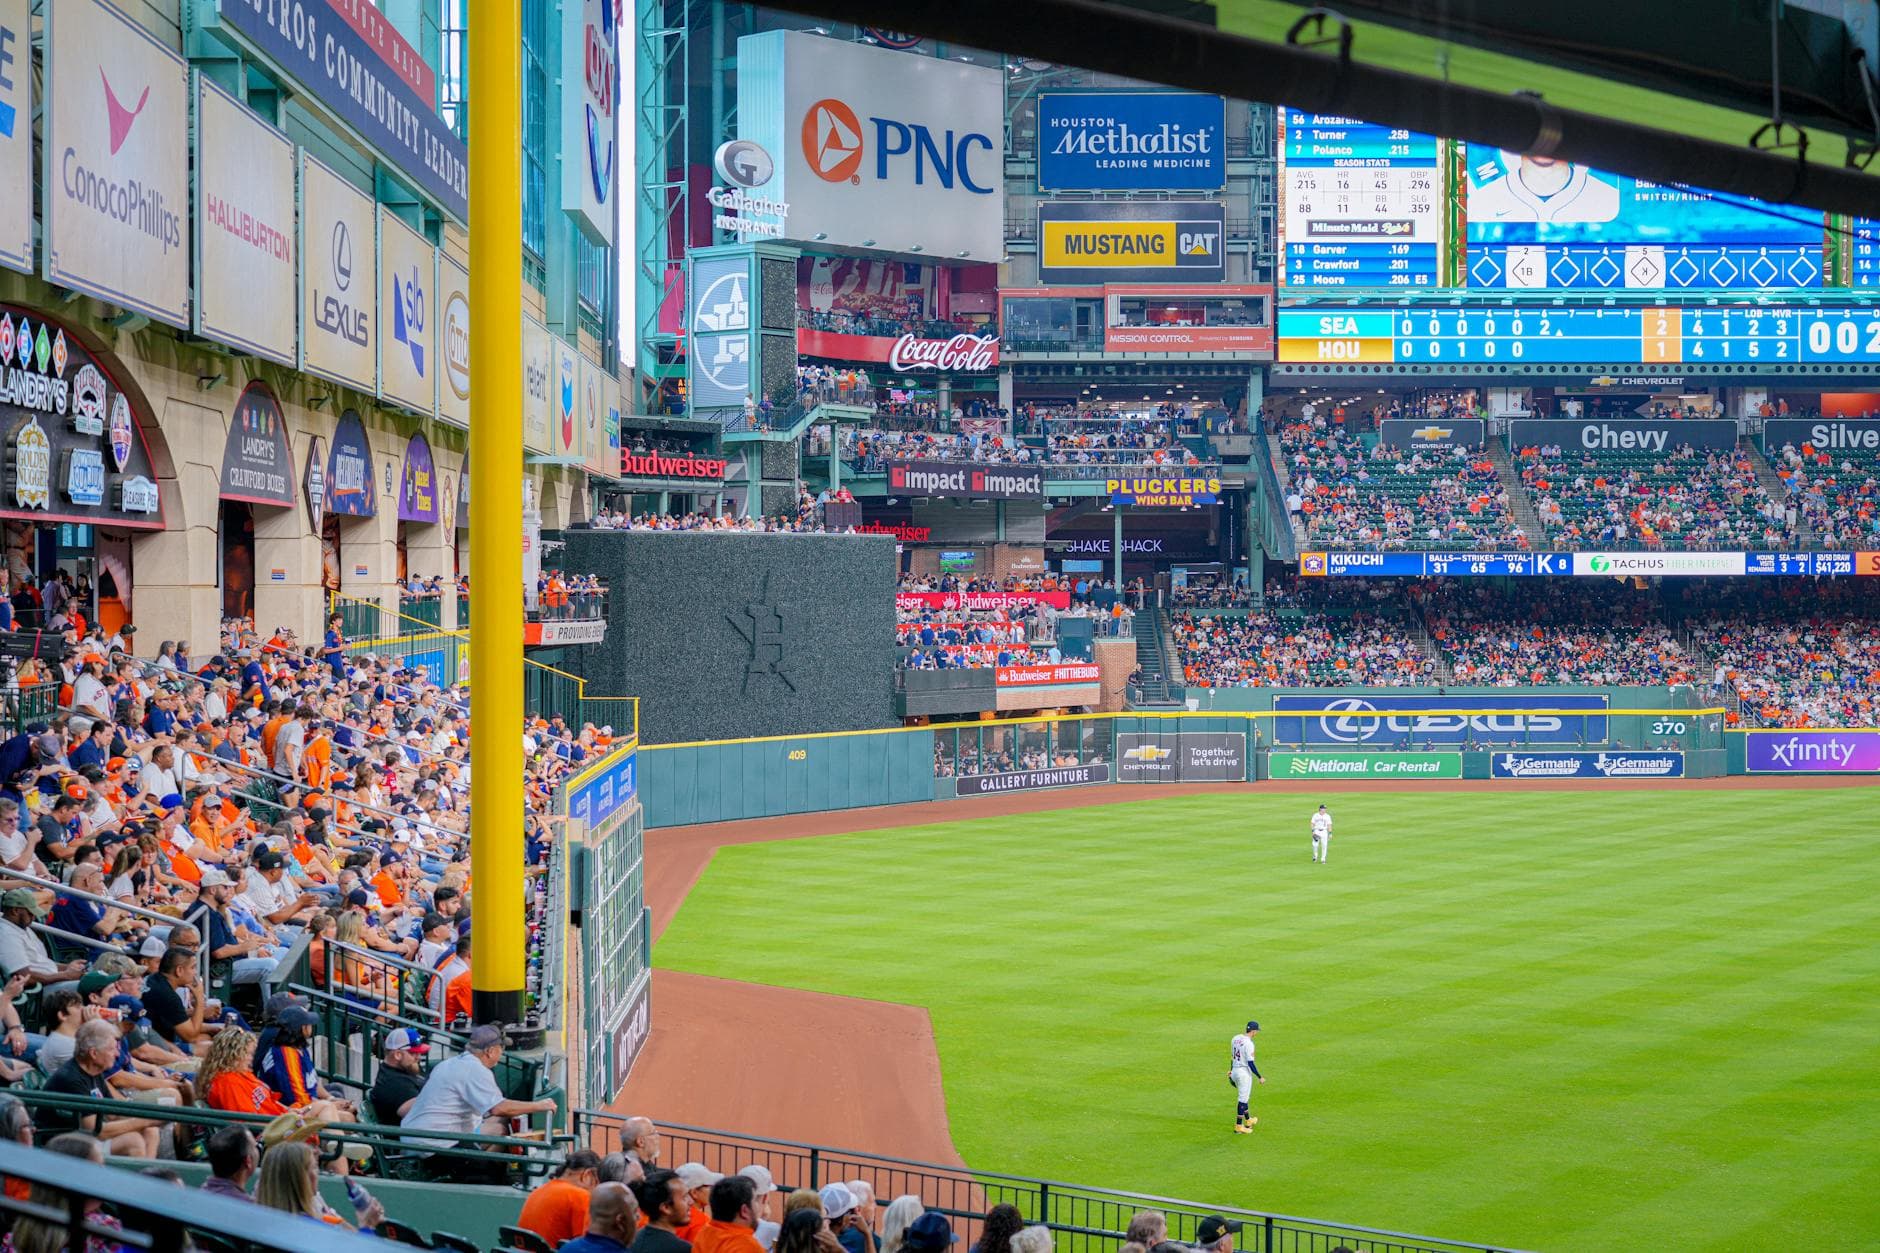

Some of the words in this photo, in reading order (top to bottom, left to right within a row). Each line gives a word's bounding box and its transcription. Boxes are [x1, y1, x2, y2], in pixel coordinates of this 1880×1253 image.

[393, 40, 420, 86] MAID
[325, 33, 419, 154] COMMUNITY
[1051, 118, 1115, 127] HOUSTON
[1292, 115, 1305, 125] 56
[1051, 123, 1211, 154] Methodist
[1295, 130, 1302, 140] 2
[1312, 130, 1347, 140] Turner
[868, 117, 994, 194] PNC
[1295, 145, 1302, 155] 7
[1312, 145, 1353, 155] Polanco
[1388, 145, 1410, 155] .215
[1096, 159, 1148, 168] LEADING
[1153, 159, 1211, 168] MEDICINE
[1334, 159, 1365, 167] SEASON
[1366, 159, 1390, 167] STATS
[1296, 171, 1314, 179] AVG
[1337, 171, 1349, 179] HR
[1374, 171, 1388, 179] RBI
[1294, 180, 1316, 189] .215
[1337, 180, 1350, 189] 16
[1375, 180, 1387, 189] 45
[1408, 180, 1430, 189] .296
[62, 147, 180, 254] ConocoPhillips
[706, 187, 790, 217] Gallagher
[1411, 194, 1427, 202] SLG
[1299, 204, 1311, 213] 88
[1337, 204, 1348, 213] 11
[1375, 204, 1387, 213] 44
[1408, 204, 1430, 213] .359
[208, 193, 290, 264] HALLIBURTON
[716, 215, 782, 237] INSURANCE
[1312, 221, 1350, 232] Minute
[1351, 221, 1379, 233] Maid
[1065, 234, 1165, 255] MUSTANG
[1179, 232, 1216, 255] CAT
[1293, 245, 1305, 254] 18
[1313, 245, 1347, 254] Garver
[1388, 245, 1410, 254] .169
[1562, 247, 1569, 256] 3
[1760, 247, 1767, 256] 8
[1800, 247, 1806, 256] 9
[1858, 245, 1871, 255] 10
[1295, 260, 1302, 269] 3
[1313, 260, 1359, 269] Crawford
[1388, 260, 1409, 269] .201
[1858, 260, 1871, 269] 14
[1521, 267, 1533, 276] 1B
[1293, 275, 1305, 285] 25
[1313, 275, 1345, 285] Moore
[1388, 275, 1410, 285] .206
[1861, 275, 1868, 284] 6
[405, 266, 425, 333] slb
[314, 288, 369, 348] LEXUS
[1431, 309, 1438, 318] 2
[1458, 309, 1465, 318] 3
[1486, 309, 1493, 318] 4
[1513, 309, 1520, 318] 5
[1541, 309, 1548, 318] 6
[1568, 309, 1576, 318] 7
[1596, 309, 1603, 318] 8
[1624, 309, 1631, 318] 9
[1694, 309, 1702, 318] H
[1744, 309, 1763, 318] LOB
[1772, 309, 1792, 318] MVR
[1816, 309, 1824, 318] B
[1843, 309, 1851, 318] S
[1319, 317, 1360, 335] SEA
[1401, 319, 1413, 336] 0
[1429, 319, 1440, 336] 0
[1456, 319, 1468, 336] 0
[1484, 319, 1496, 336] 0
[1512, 319, 1523, 336] 0
[1539, 319, 1551, 336] 2
[1656, 319, 1668, 336] 2
[1692, 319, 1704, 336] 4
[1721, 319, 1730, 336] 1
[1748, 319, 1759, 336] 2
[1776, 319, 1787, 336] 3
[1109, 335, 1147, 343] MISSION
[1150, 335, 1194, 343] CONTROL
[889, 333, 1002, 371] Coca-Cola
[1318, 341, 1361, 359] HOU
[1401, 341, 1413, 358] 0
[1429, 341, 1440, 358] 0
[1457, 341, 1466, 358] 1
[1484, 341, 1496, 358] 0
[1512, 341, 1523, 358] 0
[1657, 341, 1666, 358] 1
[1692, 341, 1704, 358] 4
[1721, 341, 1730, 358] 1
[1748, 341, 1759, 358] 5
[1776, 341, 1787, 358] 2
[1622, 377, 1684, 385] CHEVROLET
[0, 366, 68, 415] LANDRY'S
[1582, 424, 1668, 452] Chevy
[241, 436, 275, 460] LANDRY'S
[17, 450, 49, 467] GOLDEN
[620, 447, 728, 478] Budweiser
[17, 467, 49, 486] NUGGET
[230, 467, 265, 491] CRAWFORD
[267, 472, 286, 495] BOXES
[905, 464, 965, 493] impact
[984, 468, 1040, 496] impact
[1107, 479, 1221, 494] PLUCKERS
[1136, 495, 1167, 505] WING
[1169, 495, 1193, 505] BAR
[1066, 540, 1110, 552] SHAKE
[1331, 554, 1384, 565] KIKUCHI
[1538, 554, 1553, 573] K
[1558, 559, 1567, 570] 8
[1433, 563, 1448, 573] 31
[1471, 563, 1486, 573] 65
[1508, 563, 1523, 573] 96
[1613, 559, 1664, 569] TACHUS
[1781, 562, 1787, 572] 3
[1799, 562, 1805, 572] 2
[1816, 562, 1851, 573] $41,220
[558, 626, 593, 640] PROVIDING
[1010, 669, 1052, 682] Budweiser
[1054, 667, 1099, 680] #HITTHEBUDS
[1652, 722, 1686, 735] 370
[788, 750, 807, 761] 409
[1190, 747, 1236, 758] Together
[1771, 737, 1856, 767] xfinity
[1191, 757, 1211, 766] let's
[1213, 757, 1238, 766] drive
[1308, 758, 1369, 772] National
[1374, 761, 1397, 772] Car
[1398, 761, 1440, 772] Rental
[1524, 758, 1581, 769] Germania
[1616, 758, 1673, 769] Germania
[980, 775, 1027, 791] GALLERY
[1031, 769, 1089, 786] FURNITURE
